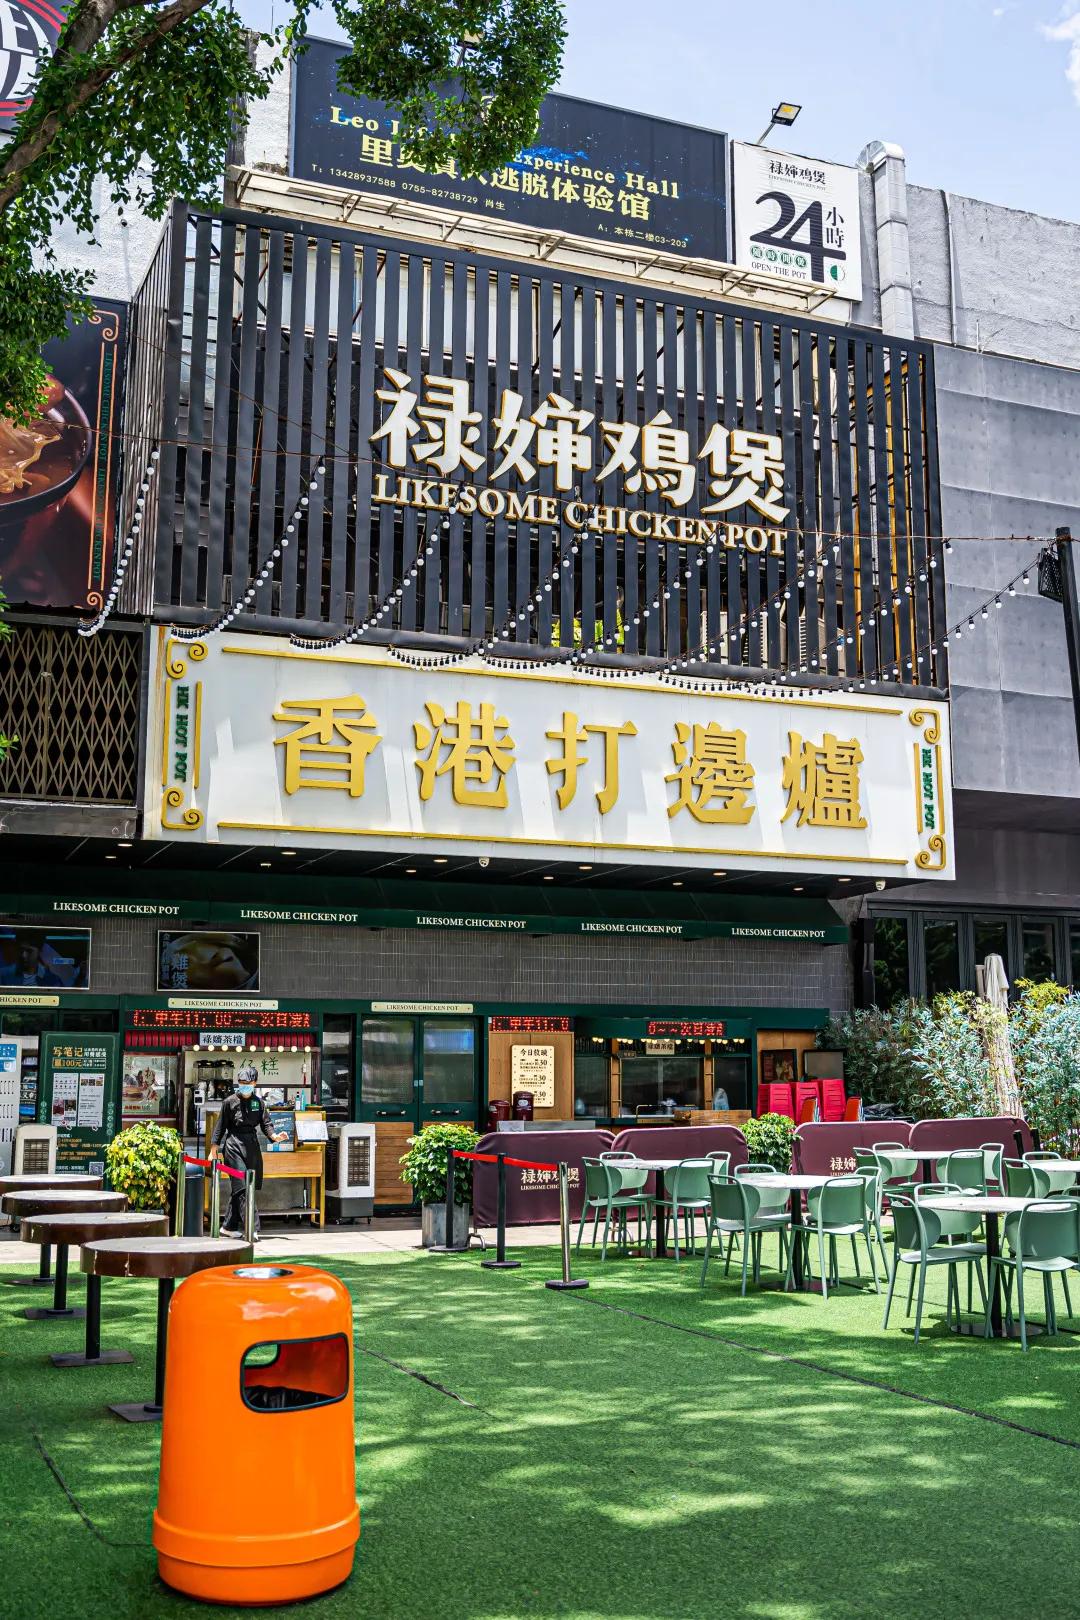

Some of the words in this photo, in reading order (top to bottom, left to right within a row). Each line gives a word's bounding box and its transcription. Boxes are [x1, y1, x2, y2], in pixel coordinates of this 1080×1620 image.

[330, 105, 379, 131] Leo
[512, 150, 615, 184] Experience
[625, 171, 680, 199] Hall
[330, 167, 396, 188] 13428937588
[402, 182, 478, 204] 0755-82738729
[750, 191, 846, 283] 24
[826, 207, 845, 248] 小時
[751, 261, 772, 272] OPEN
[774, 266, 790, 277] THE
[792, 270, 807, 280] POT
[370, 473, 560, 526] LIKESOME
[564, 500, 721, 546] CHICKEN
[723, 524, 789, 558] POT
[176, 685, 190, 709] HK
[174, 714, 189, 747] HOT
[174, 752, 188, 783] POT
[272, 693, 868, 828] 香港打邊爐
[921, 748, 932, 769] HK
[922, 772, 934, 801] HOT
[924, 803, 935, 830] POT
[53, 902, 108, 914] LIKESOME
[109, 904, 157, 915] CHICKEN
[158, 905, 180, 915] POT
[240, 910, 291, 920] LIKESOME
[292, 912, 337, 922] CHICKEN
[338, 913, 358, 922] POT
[416, 916, 464, 926] LIKESOME
[465, 918, 507, 928] CHICKEN
[508, 920, 527, 929] POT
[581, 923, 625, 932] LIKESOME
[626, 924, 665, 933] CHICKEN
[665, 926, 683, 934] POT
[731, 927, 772, 937] LIKESOME
[772, 929, 809, 938] CHICKEN
[809, 930, 826, 938] POT
